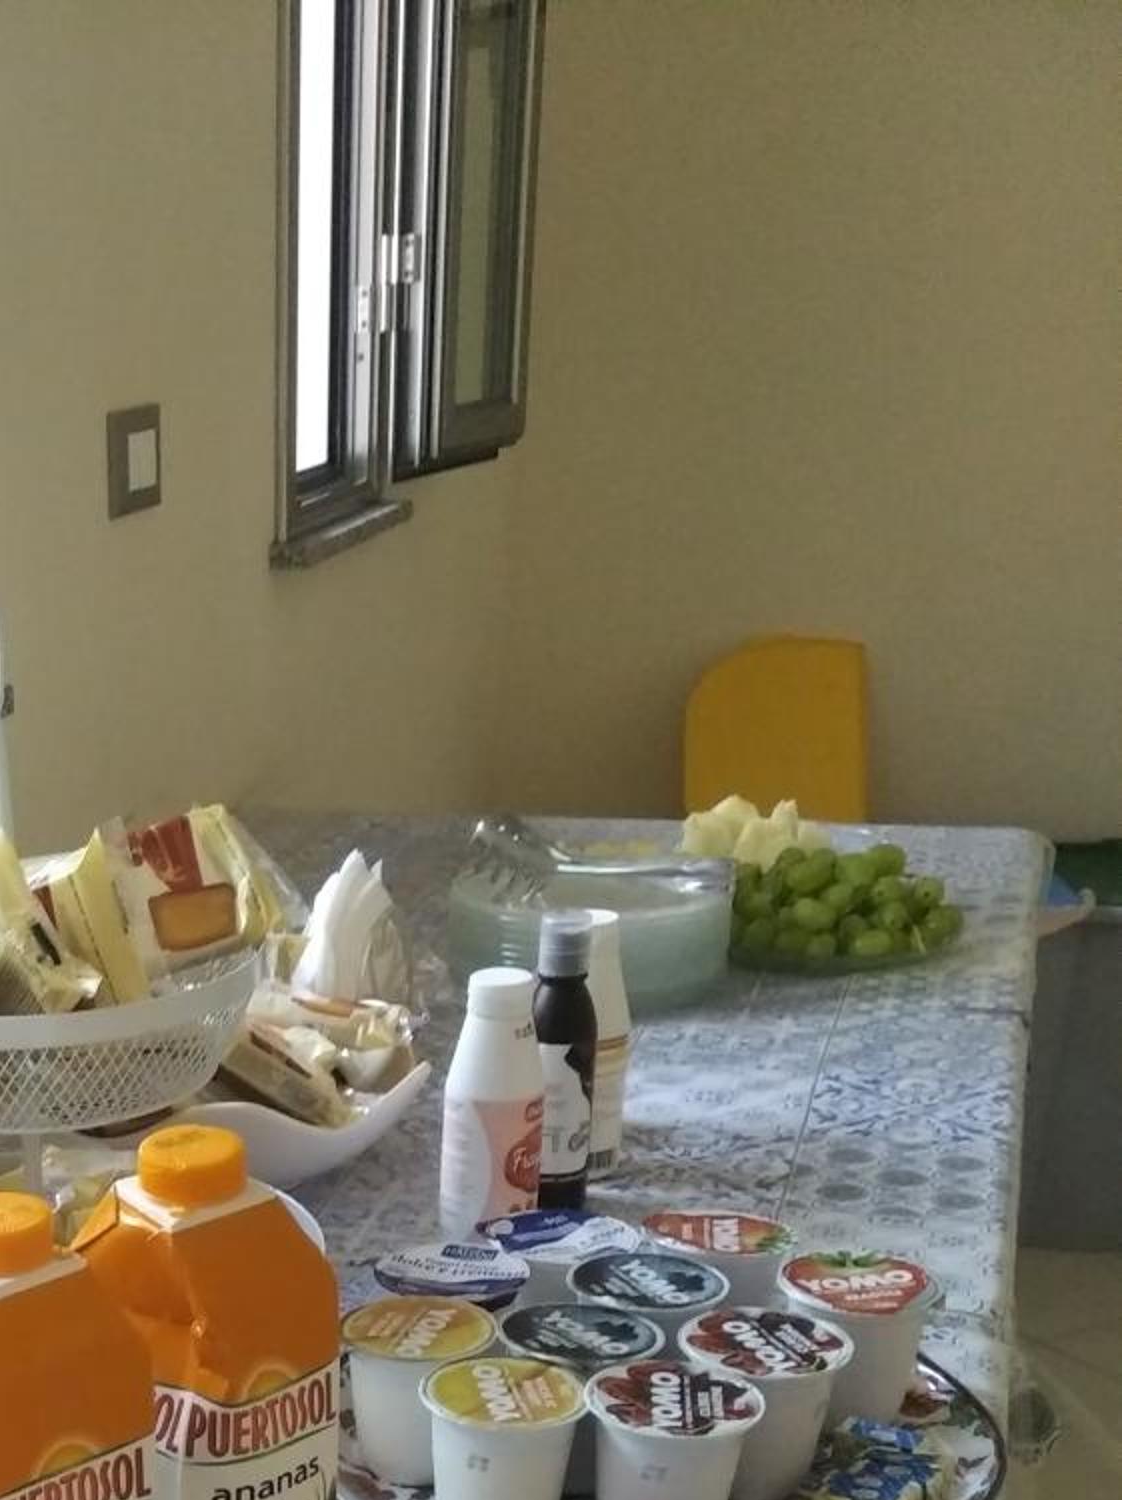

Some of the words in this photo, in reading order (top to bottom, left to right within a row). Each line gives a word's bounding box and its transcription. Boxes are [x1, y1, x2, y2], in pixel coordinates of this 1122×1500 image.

[796, 1269, 914, 1292] YOMO
[185, 1372, 337, 1458] PUERTOSOL
[471, 1364, 522, 1421] YOMO
[650, 1371, 682, 1428] YOMO
